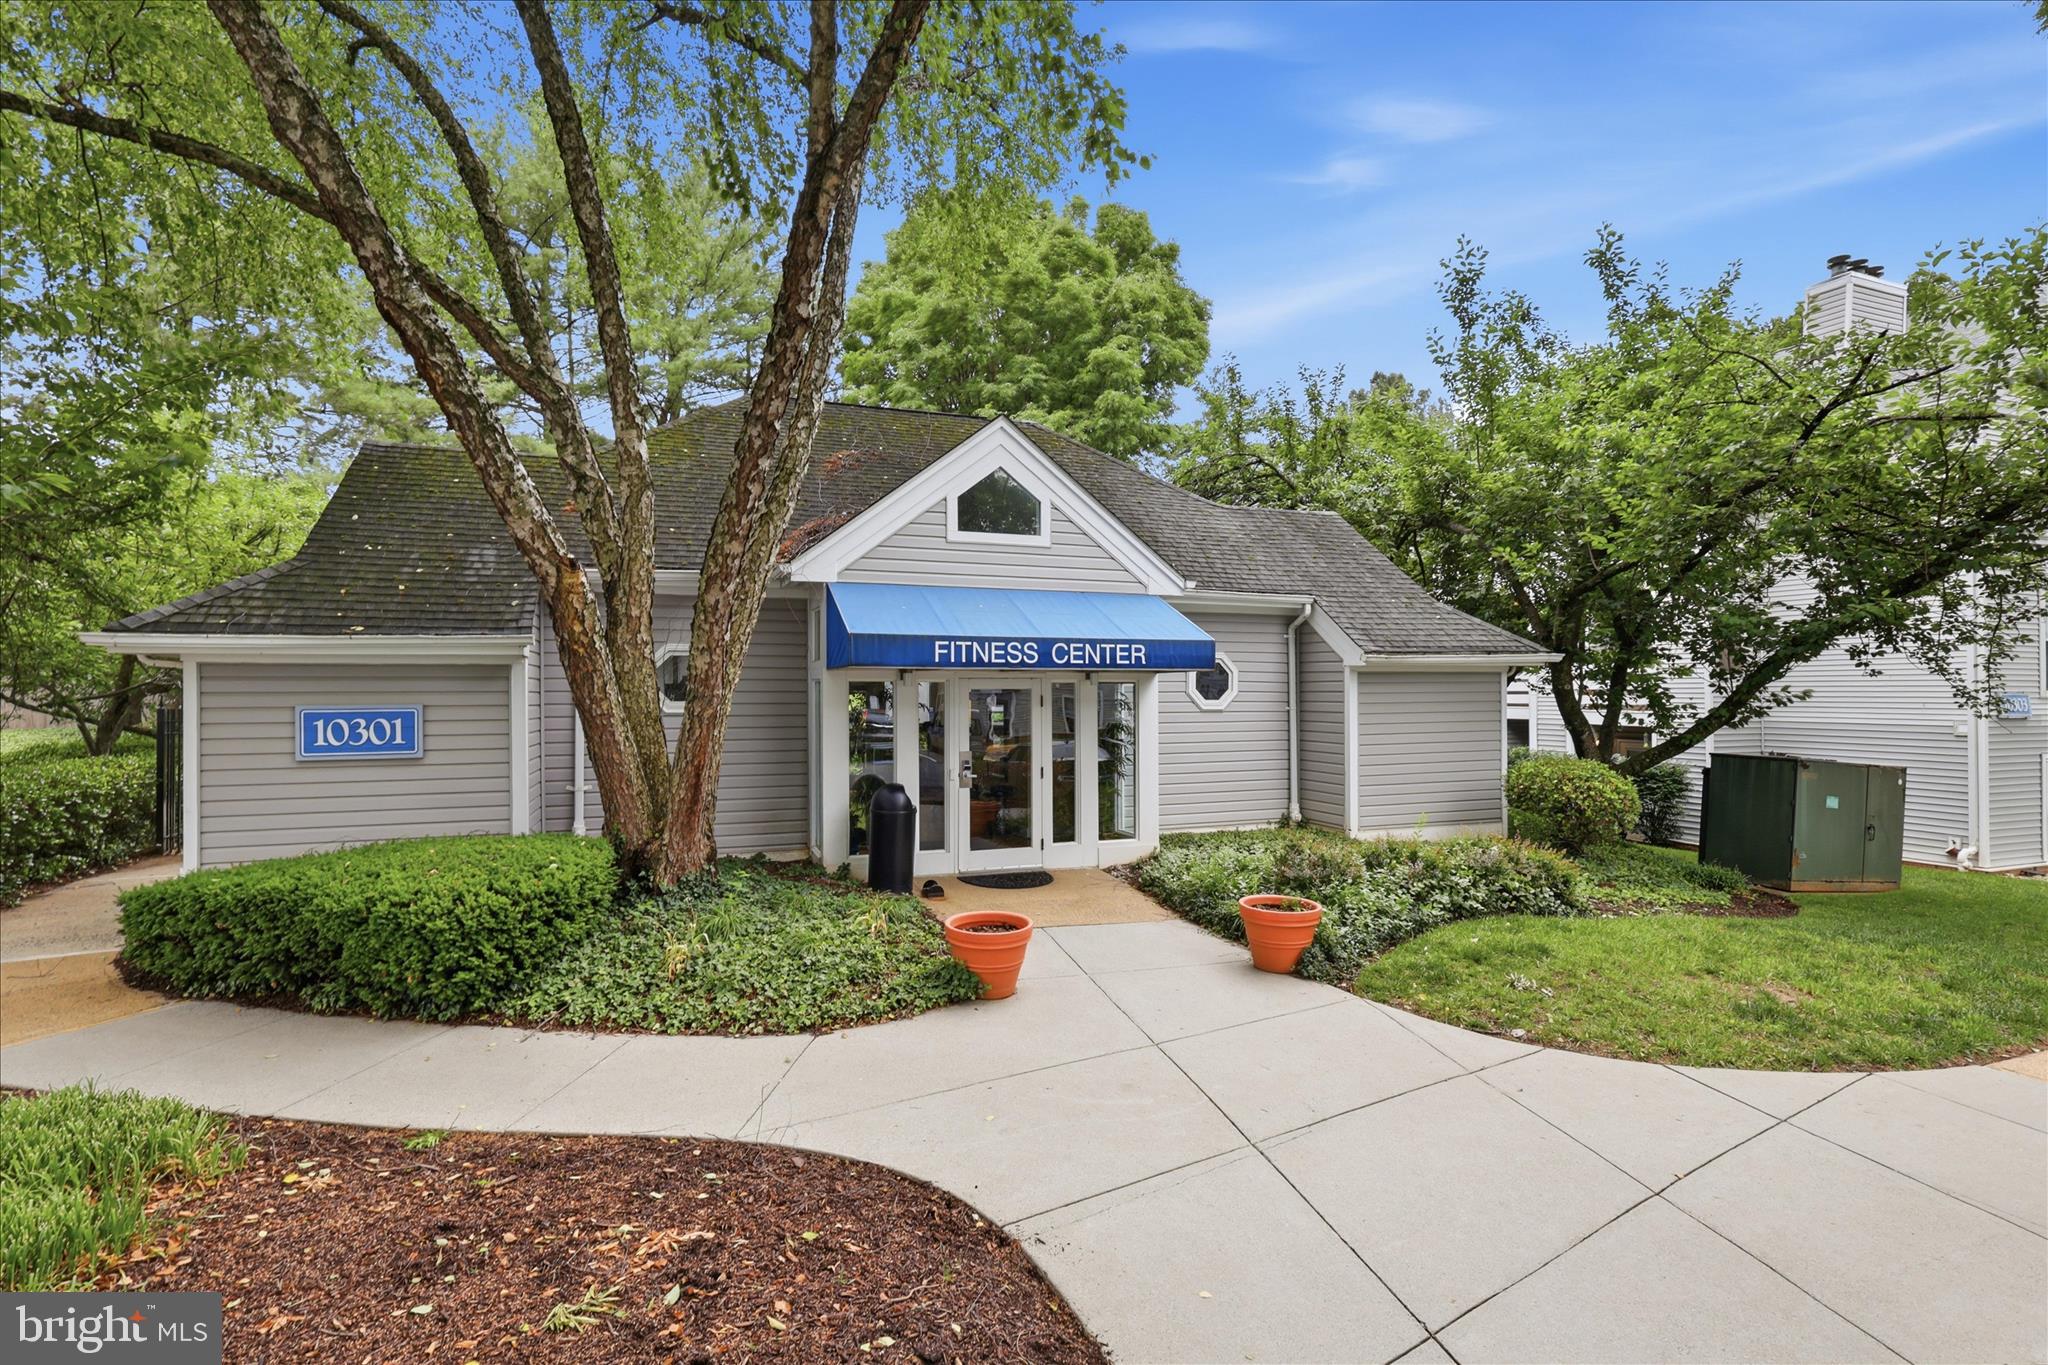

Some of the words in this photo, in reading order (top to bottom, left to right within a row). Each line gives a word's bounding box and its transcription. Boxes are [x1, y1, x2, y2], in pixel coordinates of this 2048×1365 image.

[934, 640, 1039, 665] FITNESS
[1051, 642, 1146, 665] CENTER
[312, 718, 406, 747] 10301
